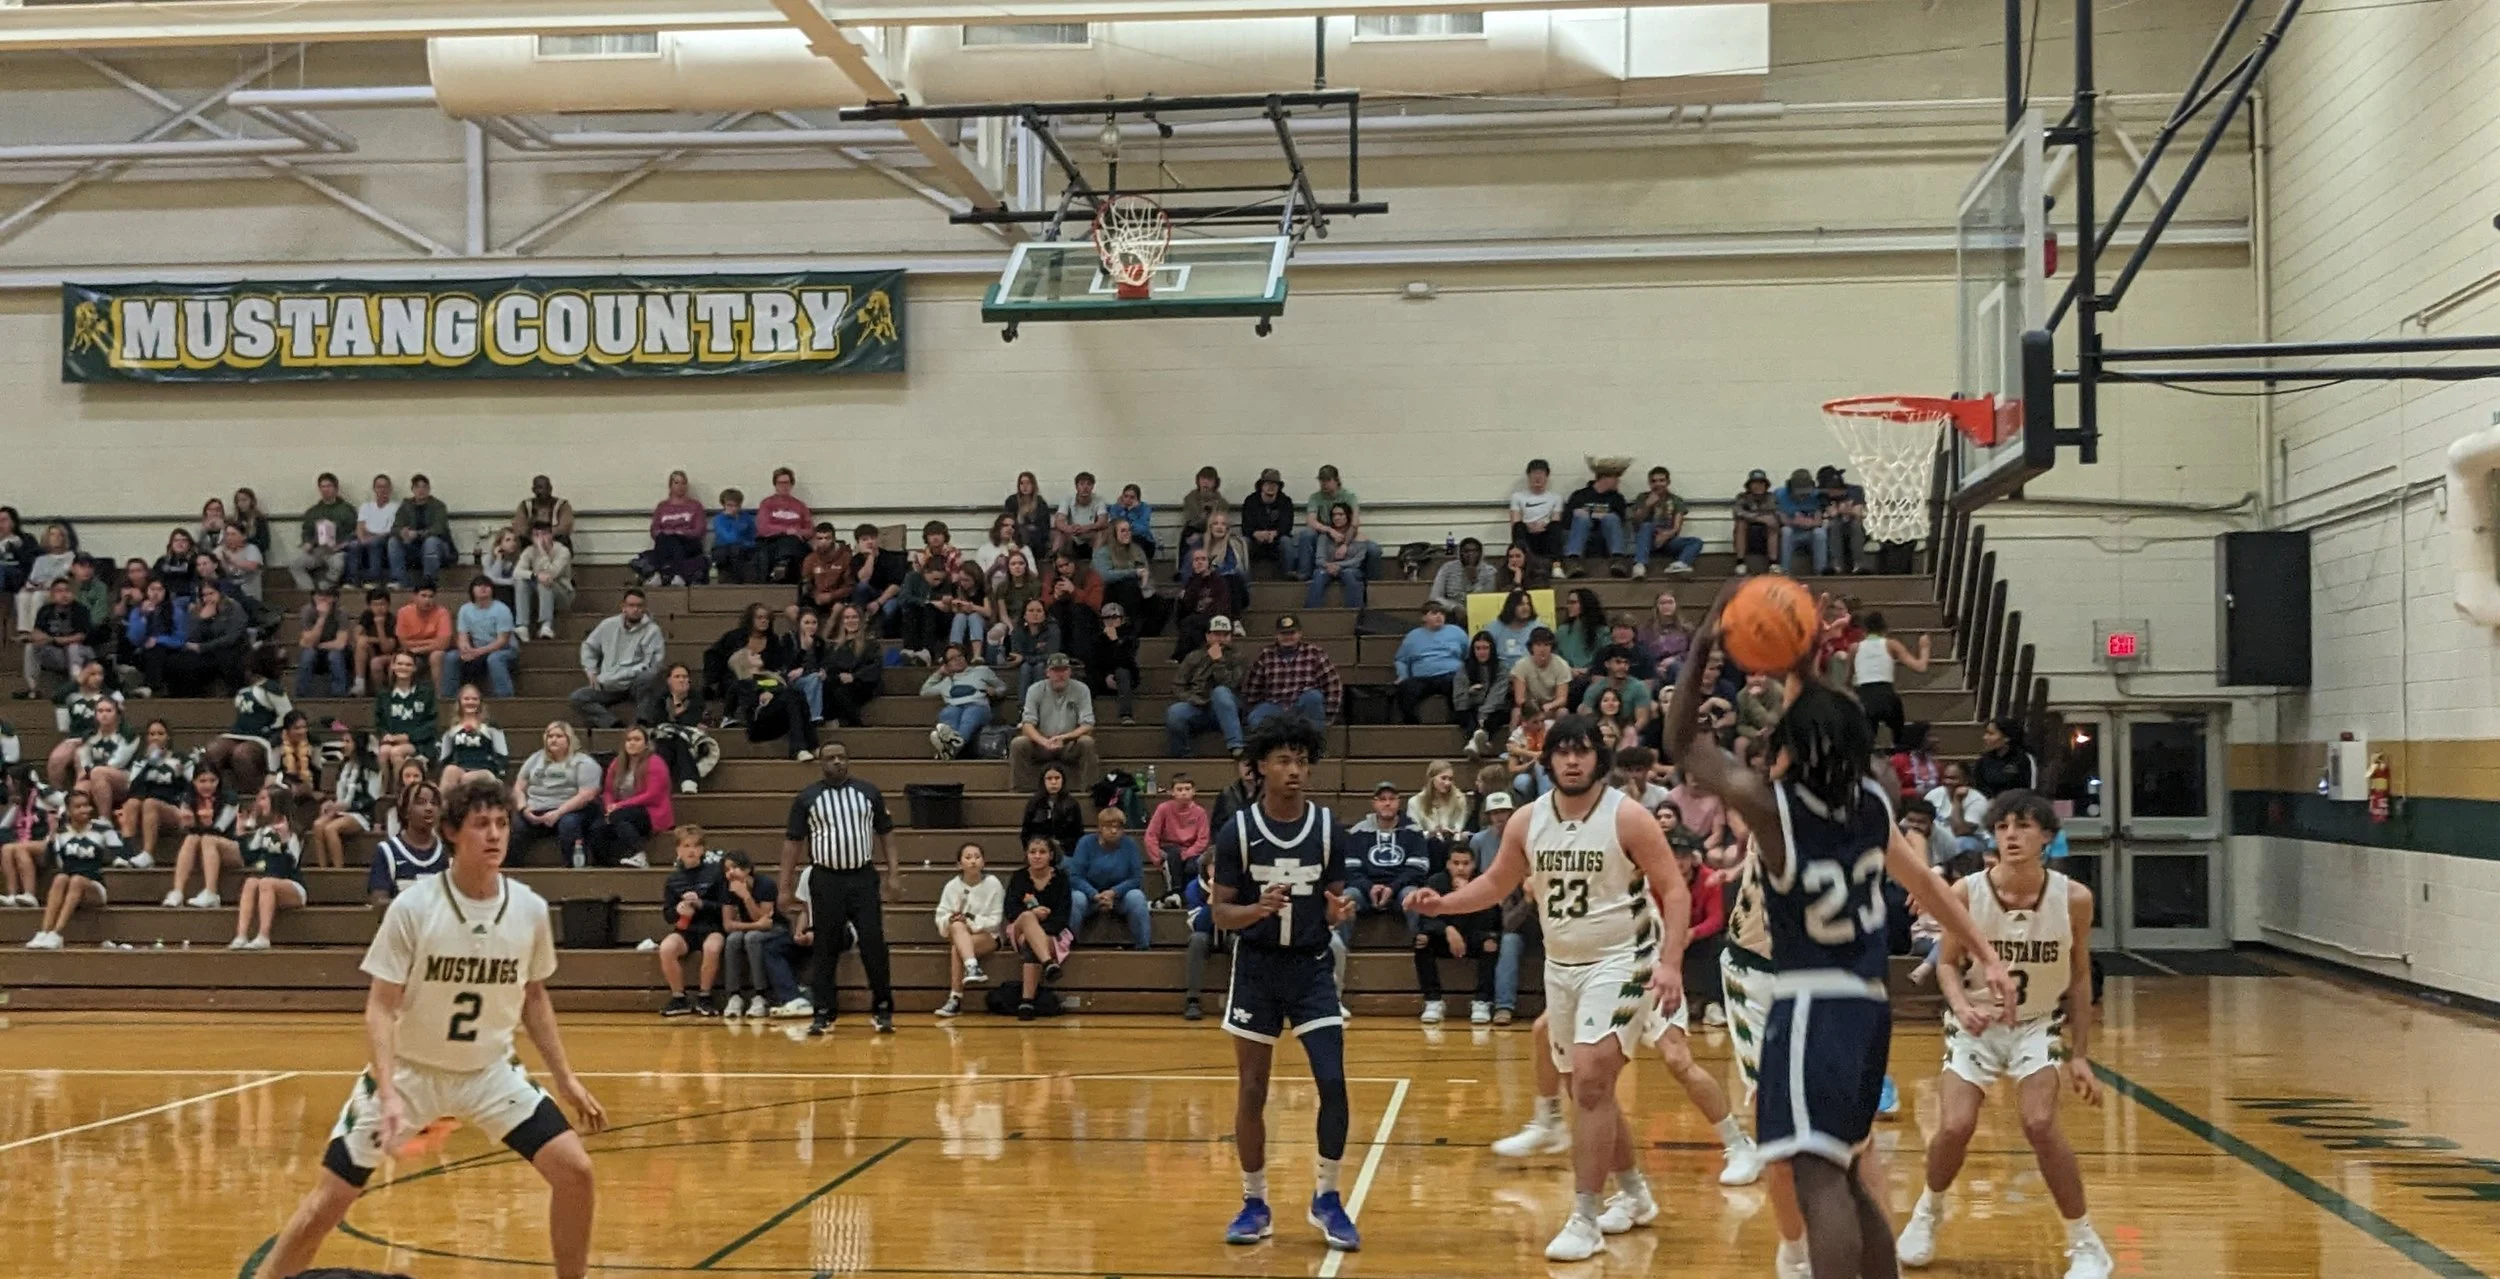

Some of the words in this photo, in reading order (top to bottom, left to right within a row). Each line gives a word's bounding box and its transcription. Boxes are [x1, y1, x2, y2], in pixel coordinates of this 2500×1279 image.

[121, 298, 478, 359] MUSTANG
[496, 291, 848, 354] COUNTRY
[455, 733, 481, 747] NM
[66, 843, 95, 858] NM
[1535, 850, 1604, 872] MUSTANGS
[1548, 878, 1588, 918] 23
[1802, 848, 1886, 945] 23
[424, 955, 519, 985] MUSTANGS
[447, 991, 483, 1042] 2
